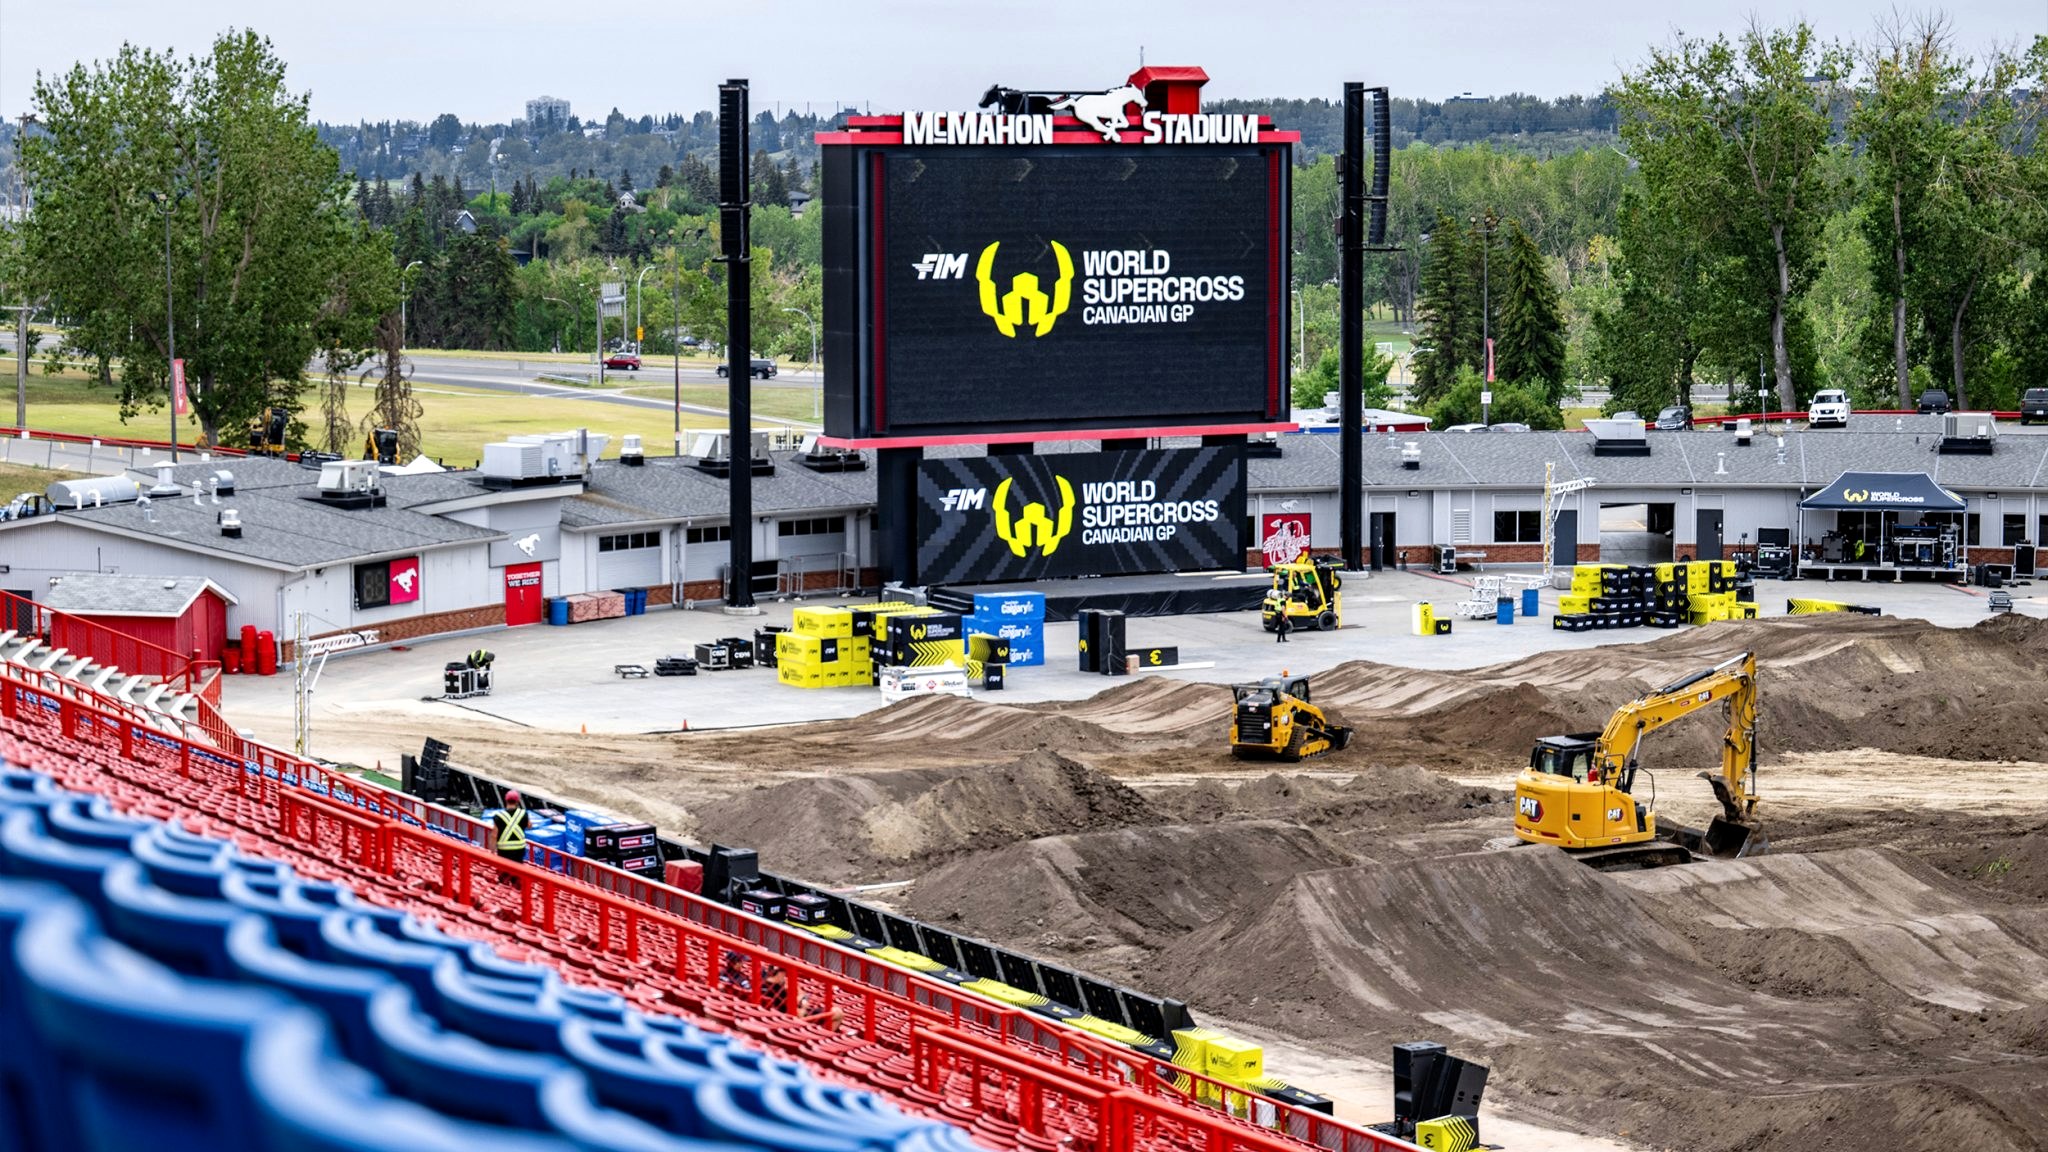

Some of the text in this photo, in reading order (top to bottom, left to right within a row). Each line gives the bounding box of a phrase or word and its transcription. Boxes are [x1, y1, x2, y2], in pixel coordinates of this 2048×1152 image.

[1143, 111, 1258, 144] STADIUM
[912, 253, 968, 280] FIM
[1084, 250, 1169, 276] WORLD
[1083, 276, 1244, 304] SUPERCROSS
[1083, 305, 1194, 325] CANADIAN GP
[939, 488, 987, 511] FIM
[1083, 480, 1156, 502] WORLD
[1083, 500, 1219, 528] SUPERCROSS
[1083, 525, 1176, 545] CANADIAN GP
[507, 571, 540, 580] TOGETHER
[1520, 796, 1538, 817] CAT
[1608, 808, 1621, 820] CAT
